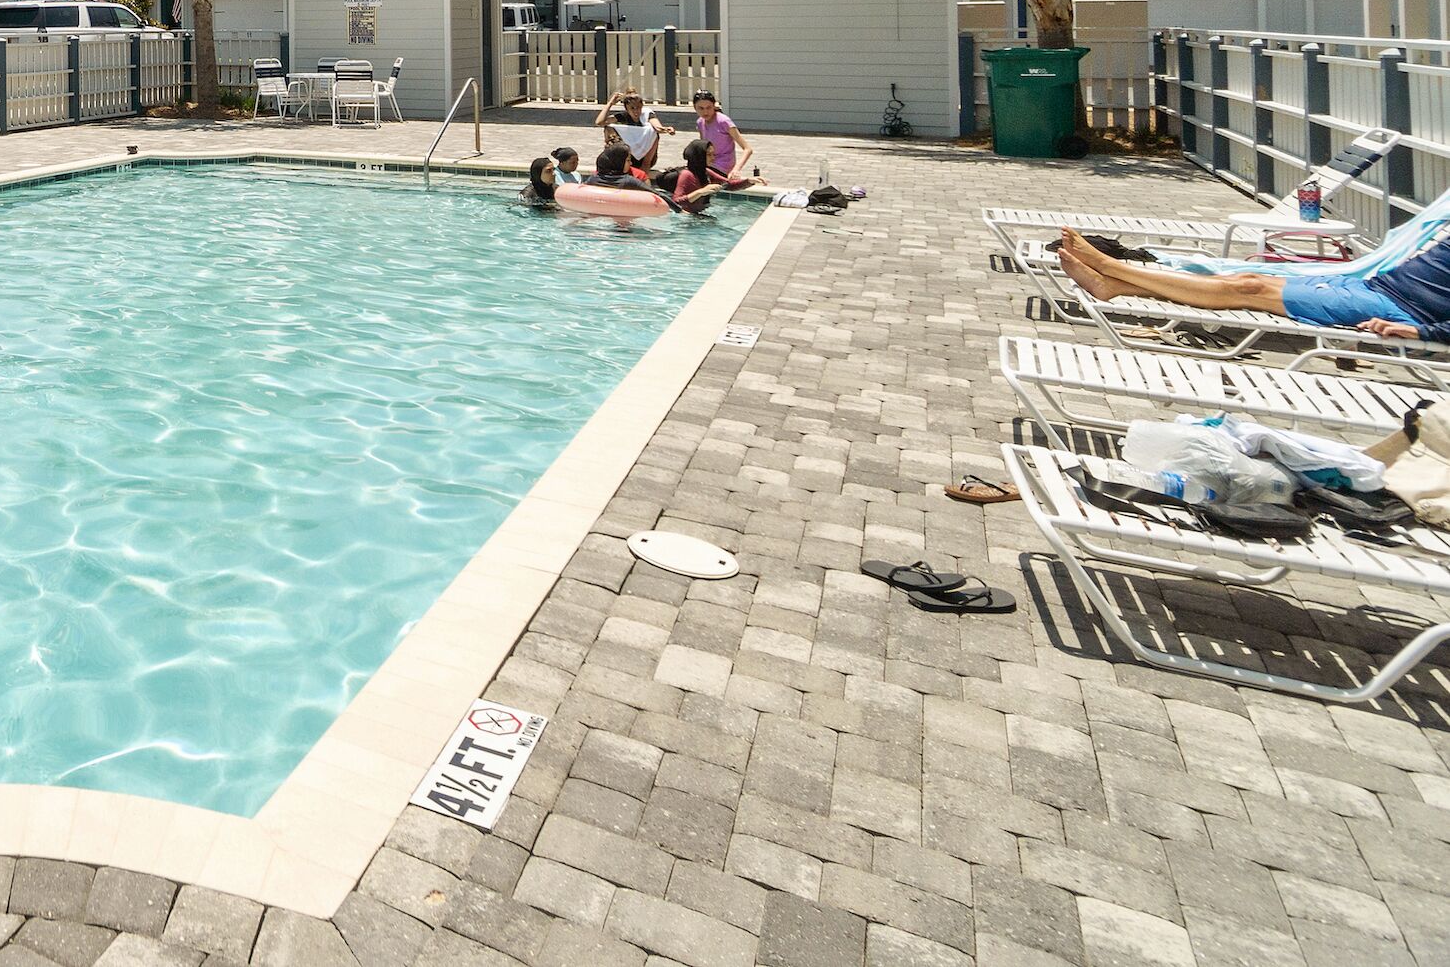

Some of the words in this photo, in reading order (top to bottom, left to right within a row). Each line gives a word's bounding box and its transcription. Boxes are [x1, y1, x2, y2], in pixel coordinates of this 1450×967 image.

[350, 36, 357, 44] NO
[358, 36, 374, 44] DIVING
[522, 716, 544, 737] DIVING
[516, 737, 533, 748] NO
[449, 736, 517, 780] FT.
